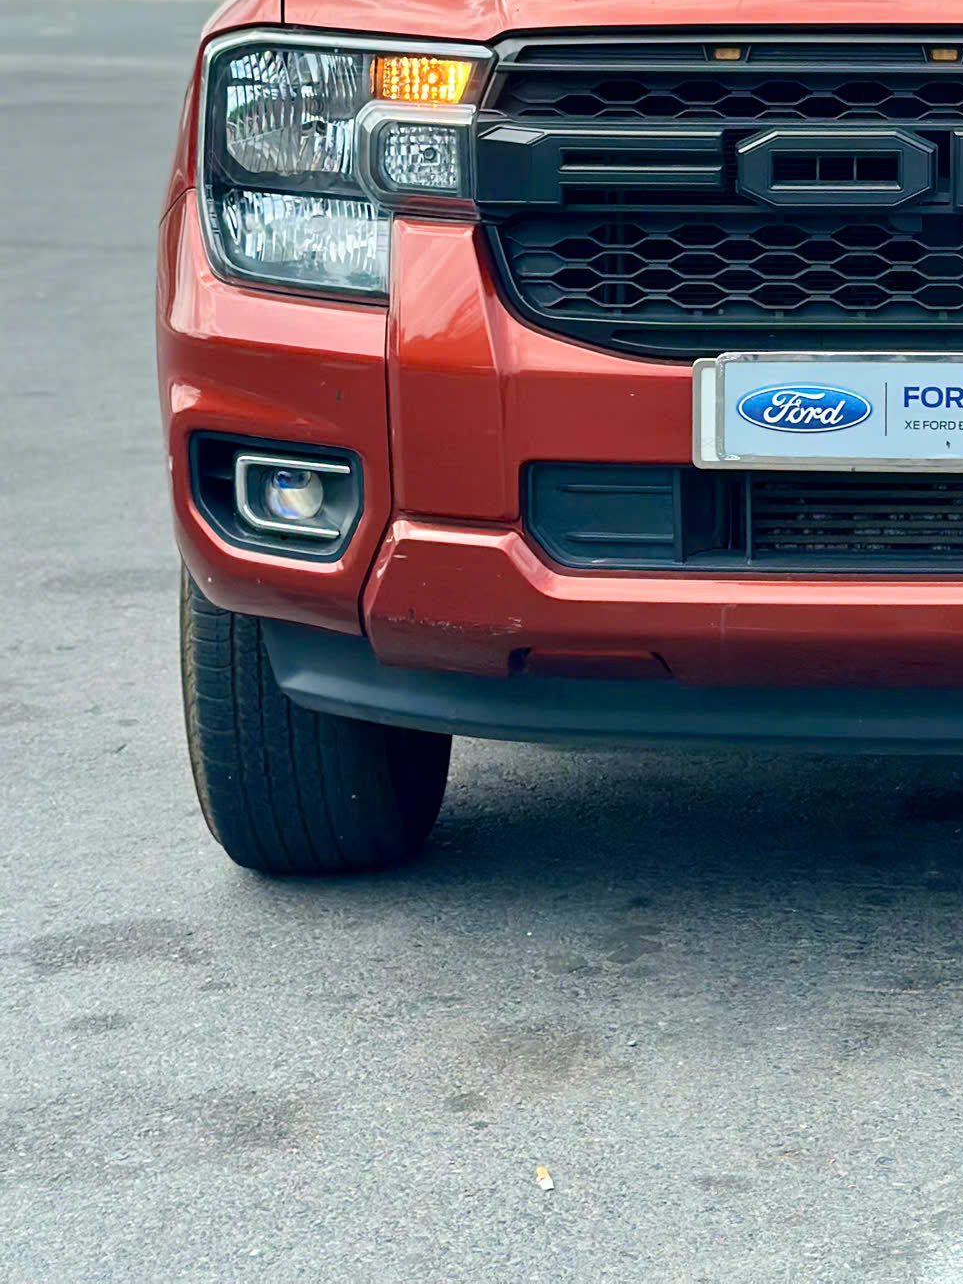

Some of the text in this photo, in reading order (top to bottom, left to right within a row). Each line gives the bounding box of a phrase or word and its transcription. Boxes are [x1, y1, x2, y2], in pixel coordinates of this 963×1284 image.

[763, 390, 846, 424] Ford
[904, 420, 920, 430] XE
[922, 420, 956, 430] FORD
